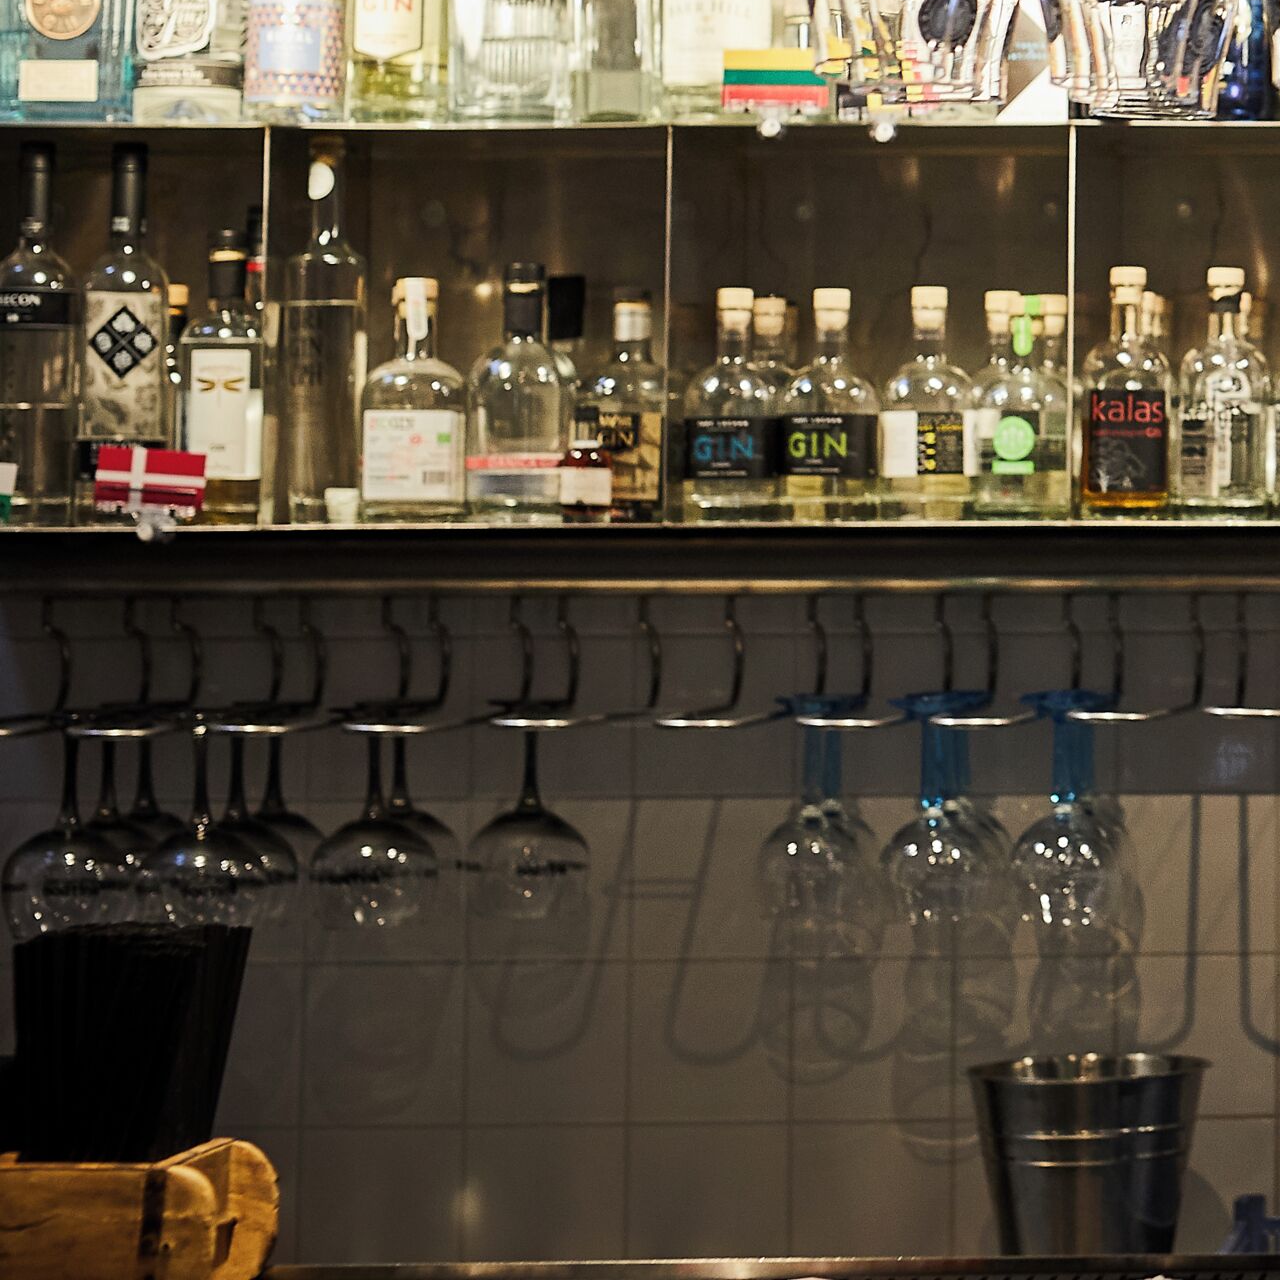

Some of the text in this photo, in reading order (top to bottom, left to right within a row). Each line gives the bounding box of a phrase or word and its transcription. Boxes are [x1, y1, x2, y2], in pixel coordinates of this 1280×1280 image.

[1091, 394, 1164, 423] kalas
[694, 433, 755, 461] GIN
[788, 431, 848, 459] GIN
